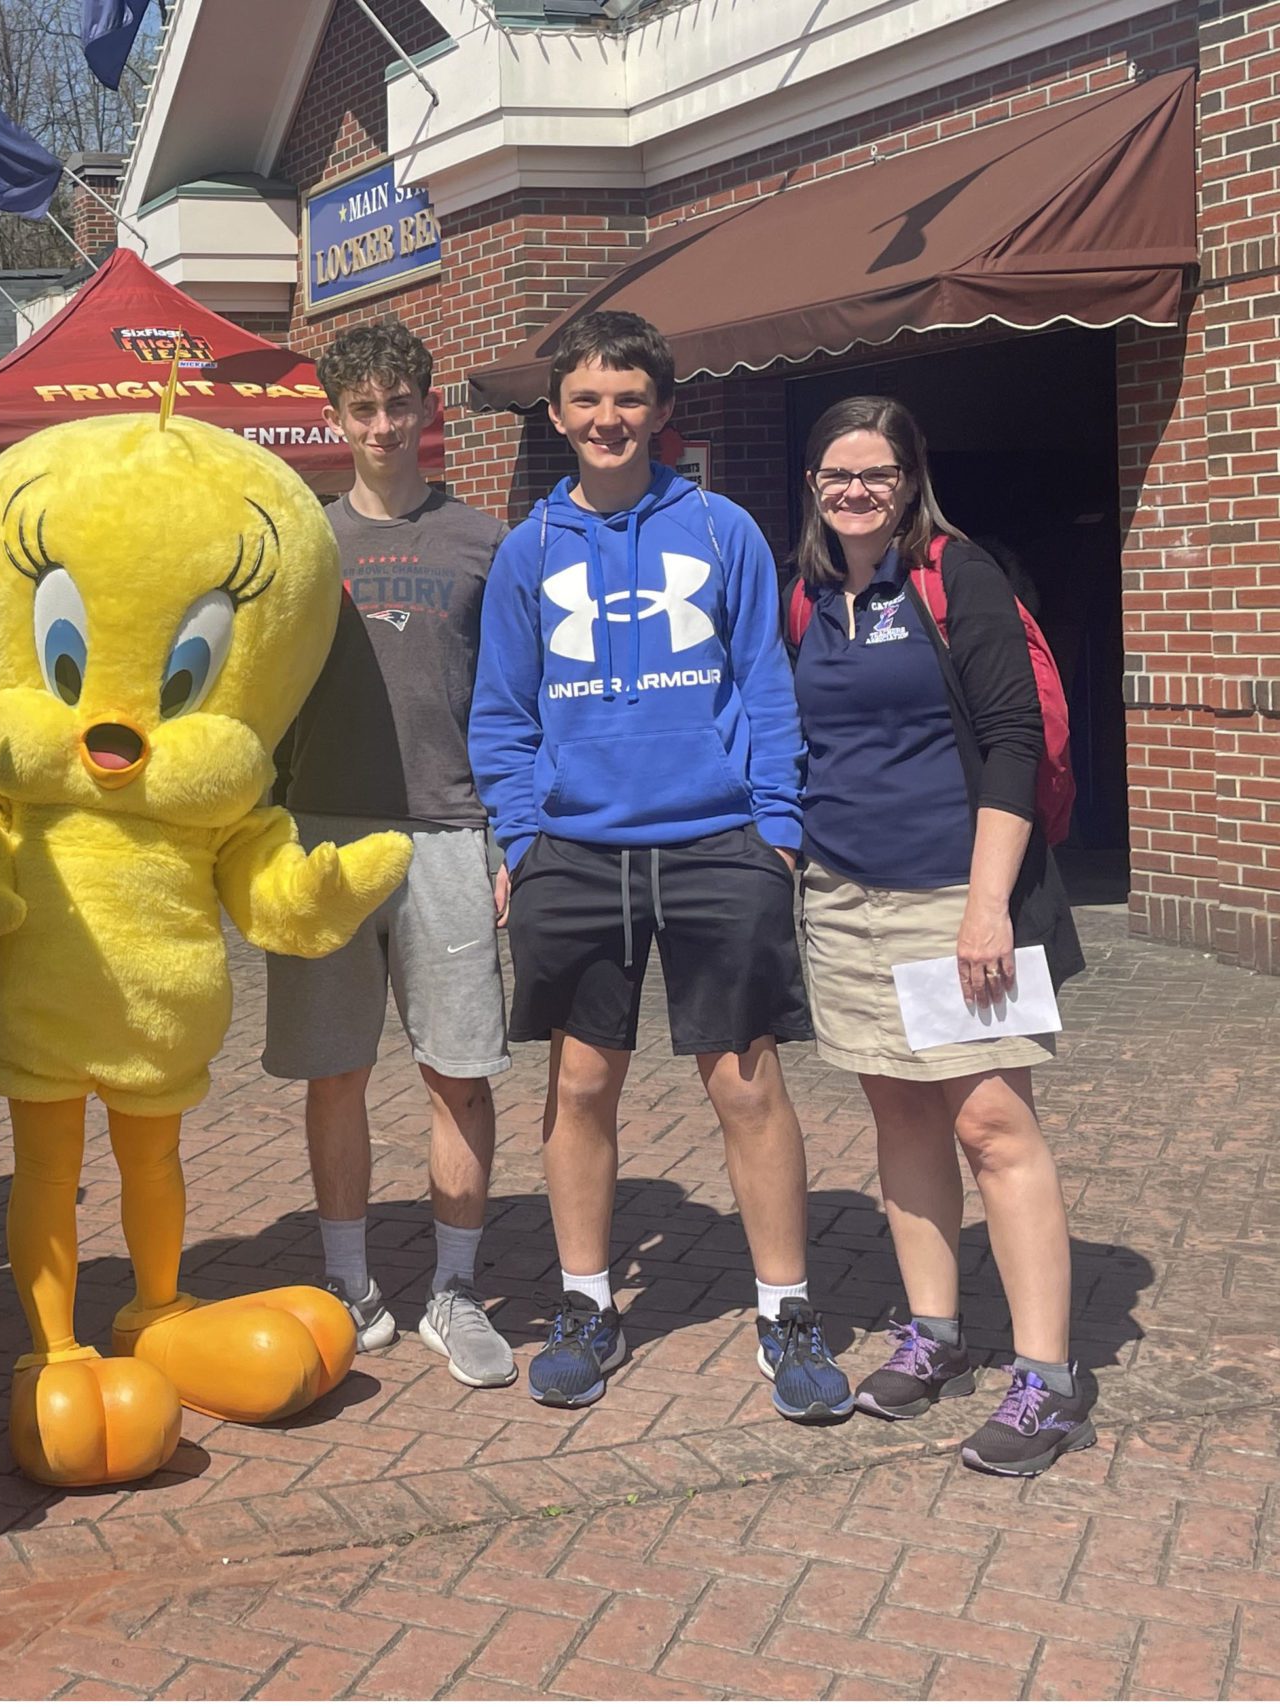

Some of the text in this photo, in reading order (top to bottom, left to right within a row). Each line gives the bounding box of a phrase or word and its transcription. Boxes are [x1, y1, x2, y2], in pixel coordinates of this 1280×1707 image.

[349, 182, 389, 222] MAIN
[316, 208, 442, 285] LOCKER REN
[121, 337, 206, 350] FRIGHT
[141, 349, 207, 361] FEST
[33, 381, 328, 402] FRIGHT PAS
[243, 426, 349, 445] ENTRAN
[342, 576, 456, 610] ICTORY
[548, 677, 622, 700] UNDER
